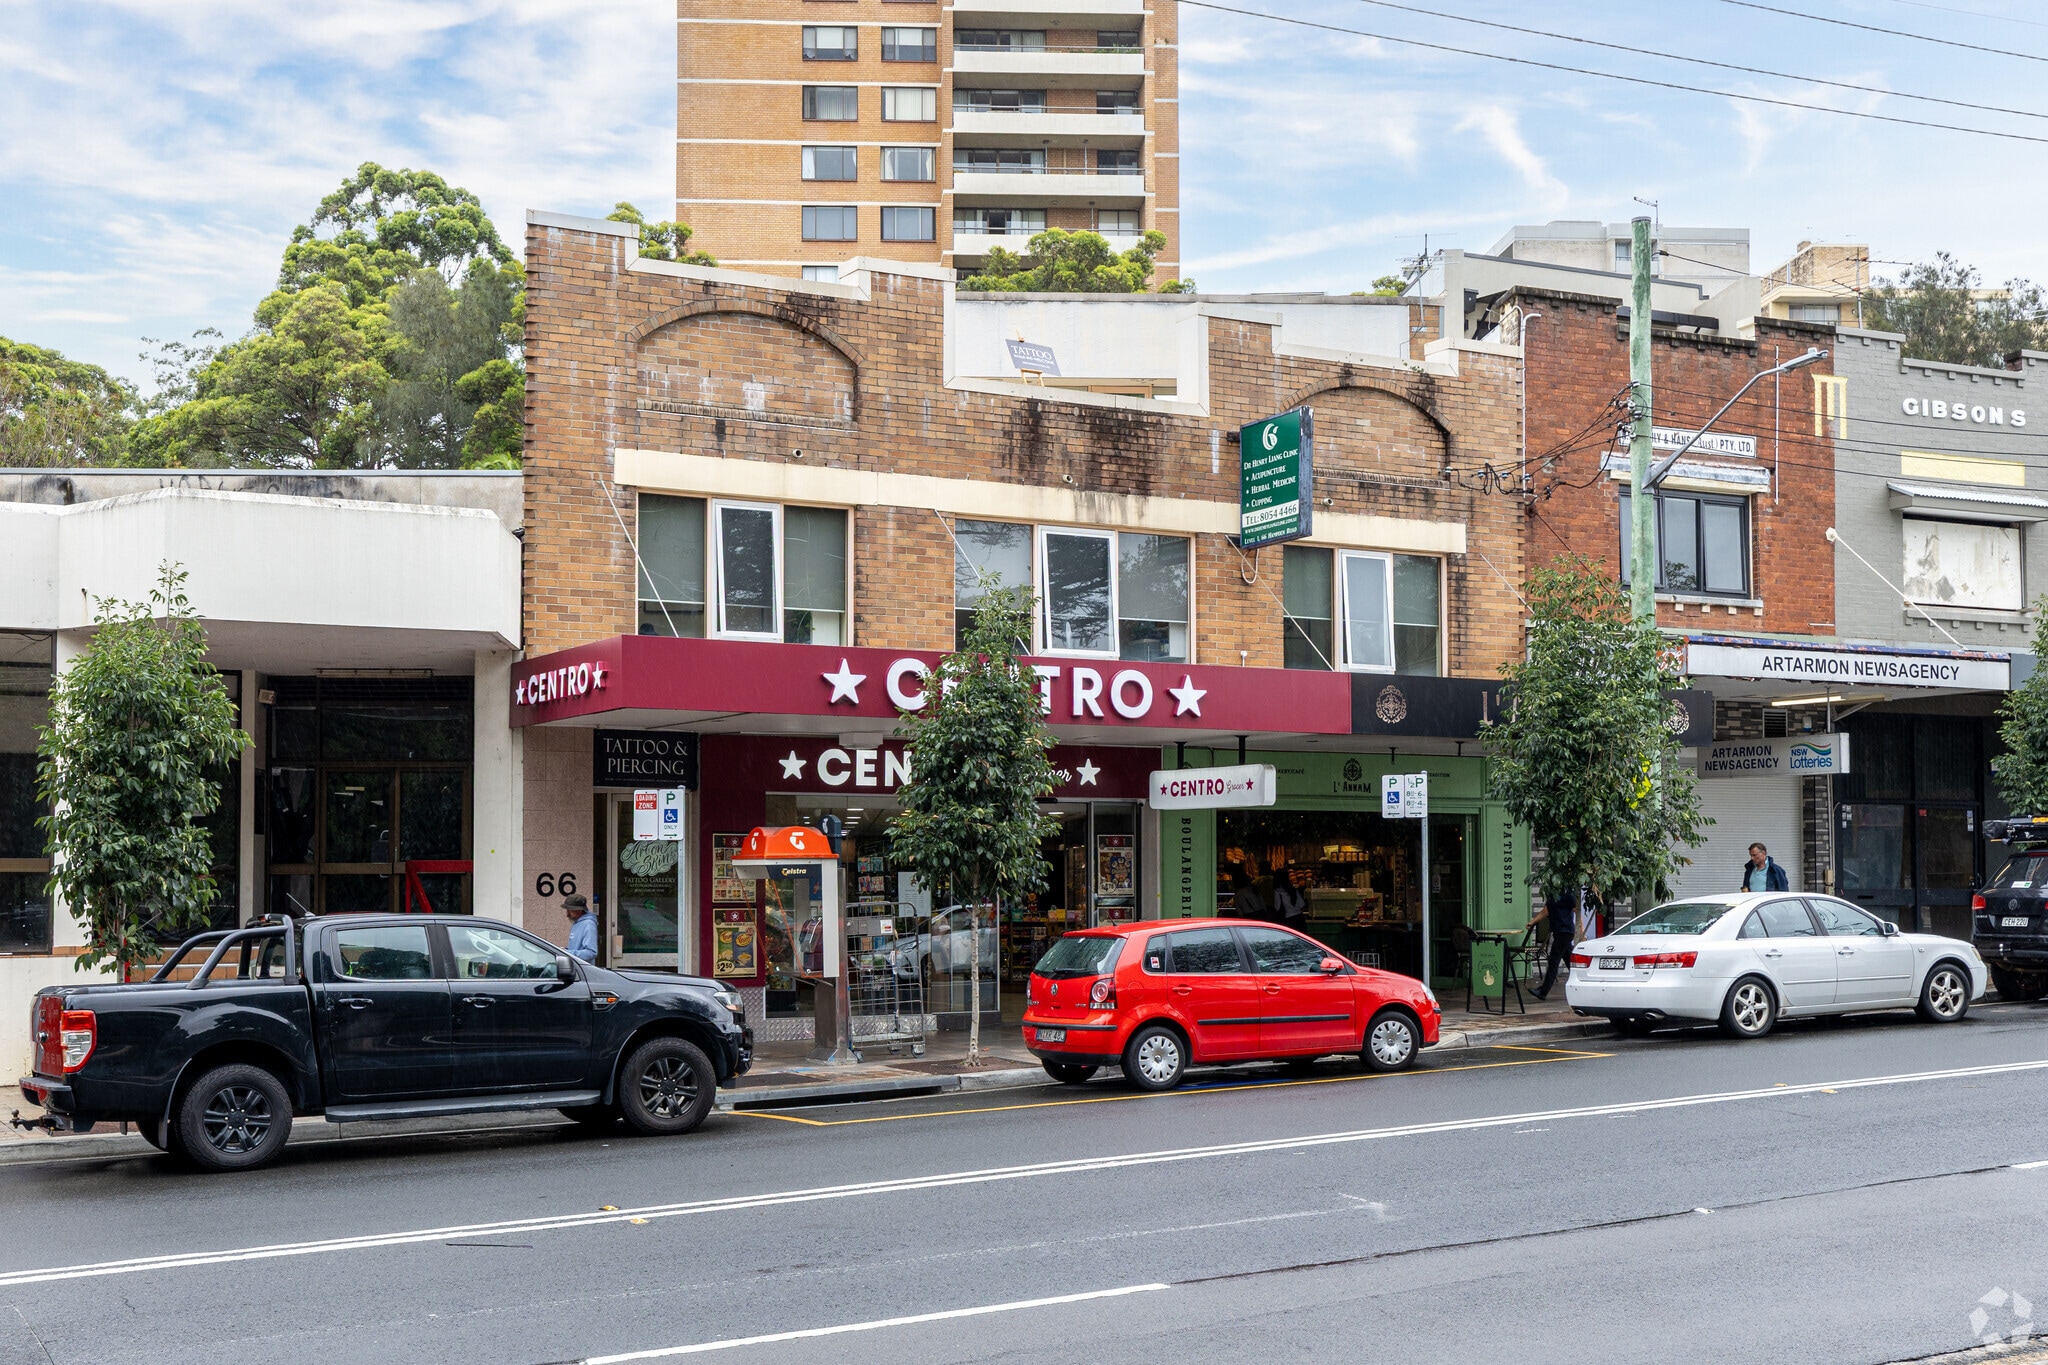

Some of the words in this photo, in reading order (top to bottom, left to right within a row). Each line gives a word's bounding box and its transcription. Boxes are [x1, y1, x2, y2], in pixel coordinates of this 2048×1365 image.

[1011, 345, 1052, 361] TATTOO
[1664, 433, 1669, 445] &
[1671, 432, 1690, 446] HANS
[1720, 439, 1736, 451] PTY.
[1738, 441, 1753, 453] LTD.
[1252, 458, 1268, 468] HENRY
[1268, 453, 1283, 463] LIANG
[1283, 449, 1299, 459] CLINIC
[1251, 465, 1286, 481] ACUPUNCTURE
[1251, 483, 1271, 494] HERBAL
[1272, 476, 1297, 489] MEDICINE
[1251, 496, 1273, 508] CUPPING
[1279, 504, 1297, 516] 4466
[1762, 655, 1850, 676] ARTARMON
[1853, 660, 1960, 681] NEWSAGENCY
[527, 663, 589, 705] CENTRO
[603, 738, 669, 755] TATTOO
[674, 741, 688, 756] &
[1712, 745, 1772, 758] ARTARMON
[608, 758, 684, 775] PIERCING
[817, 748, 912, 787] CEN
[1705, 757, 1779, 771] NEWSAGENCY
[1790, 757, 1832, 769] Lotteries
[1170, 779, 1224, 797] CENTRO
[1388, 778, 1398, 788] P
[635, 793, 657, 802] LOADING
[666, 793, 676, 805] P
[1503, 822, 1513, 904] PATISSERIE
[781, 867, 807, 876] Telstra
[535, 872, 577, 898] 66
